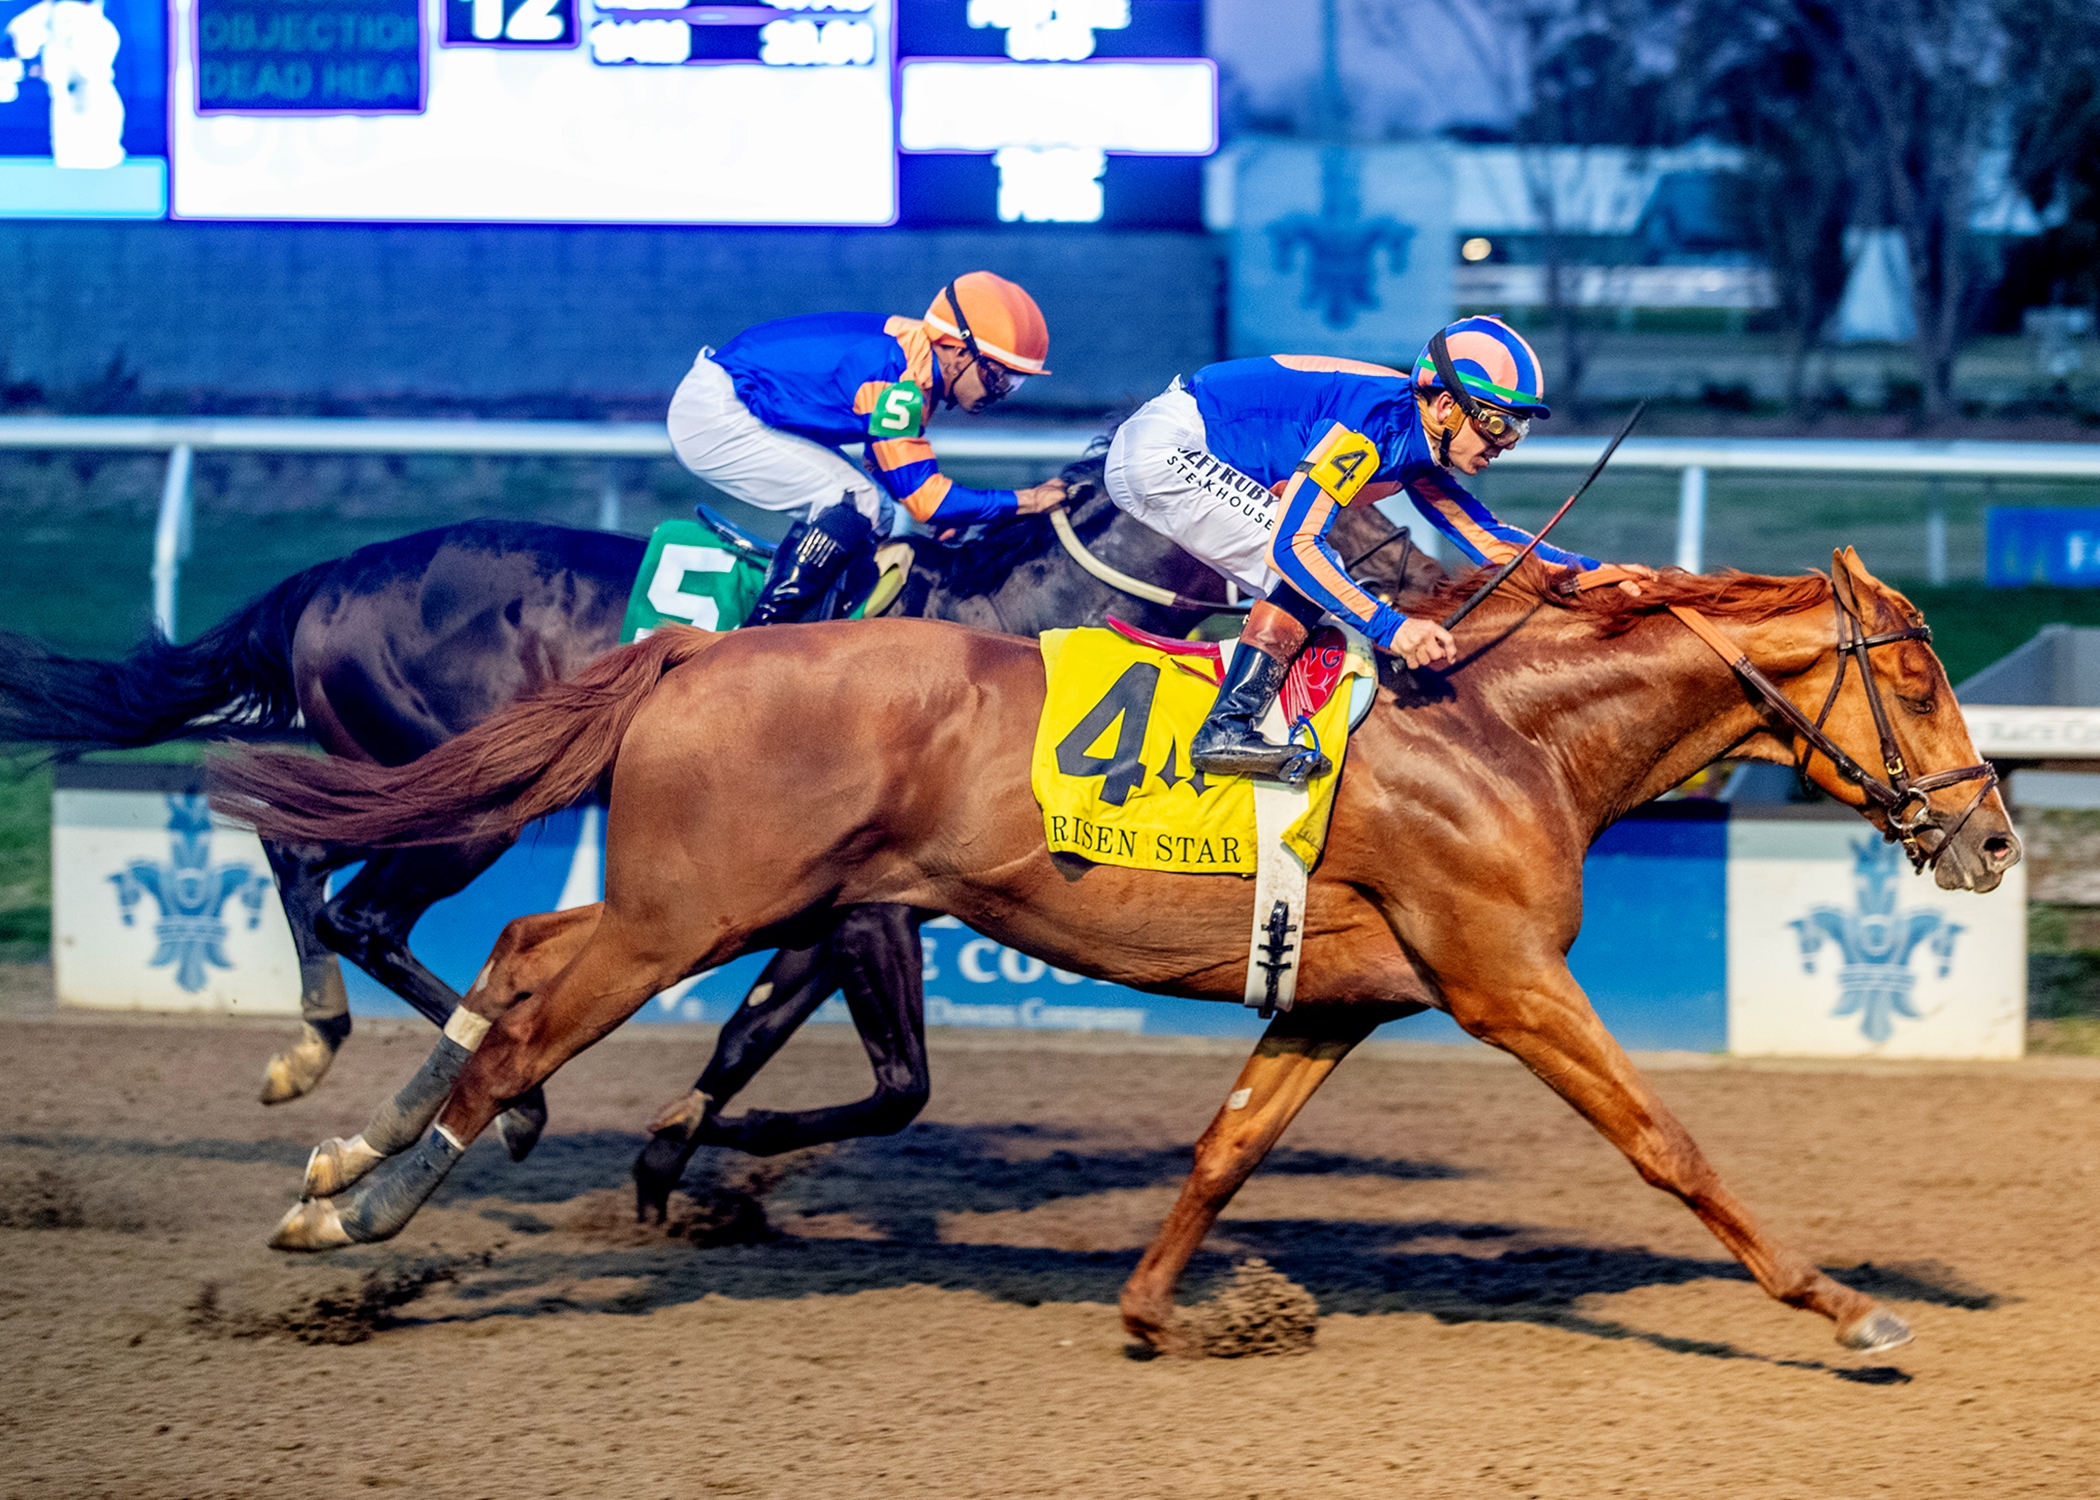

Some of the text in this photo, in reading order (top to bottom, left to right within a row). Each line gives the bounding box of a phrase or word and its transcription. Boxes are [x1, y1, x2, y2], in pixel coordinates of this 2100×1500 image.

[881, 390, 913, 430] 5
[1330, 450, 1369, 491] 4
[647, 543, 737, 645] 5
[1055, 662, 1161, 807] 4
[1051, 815, 1241, 864] RISEN STAR
